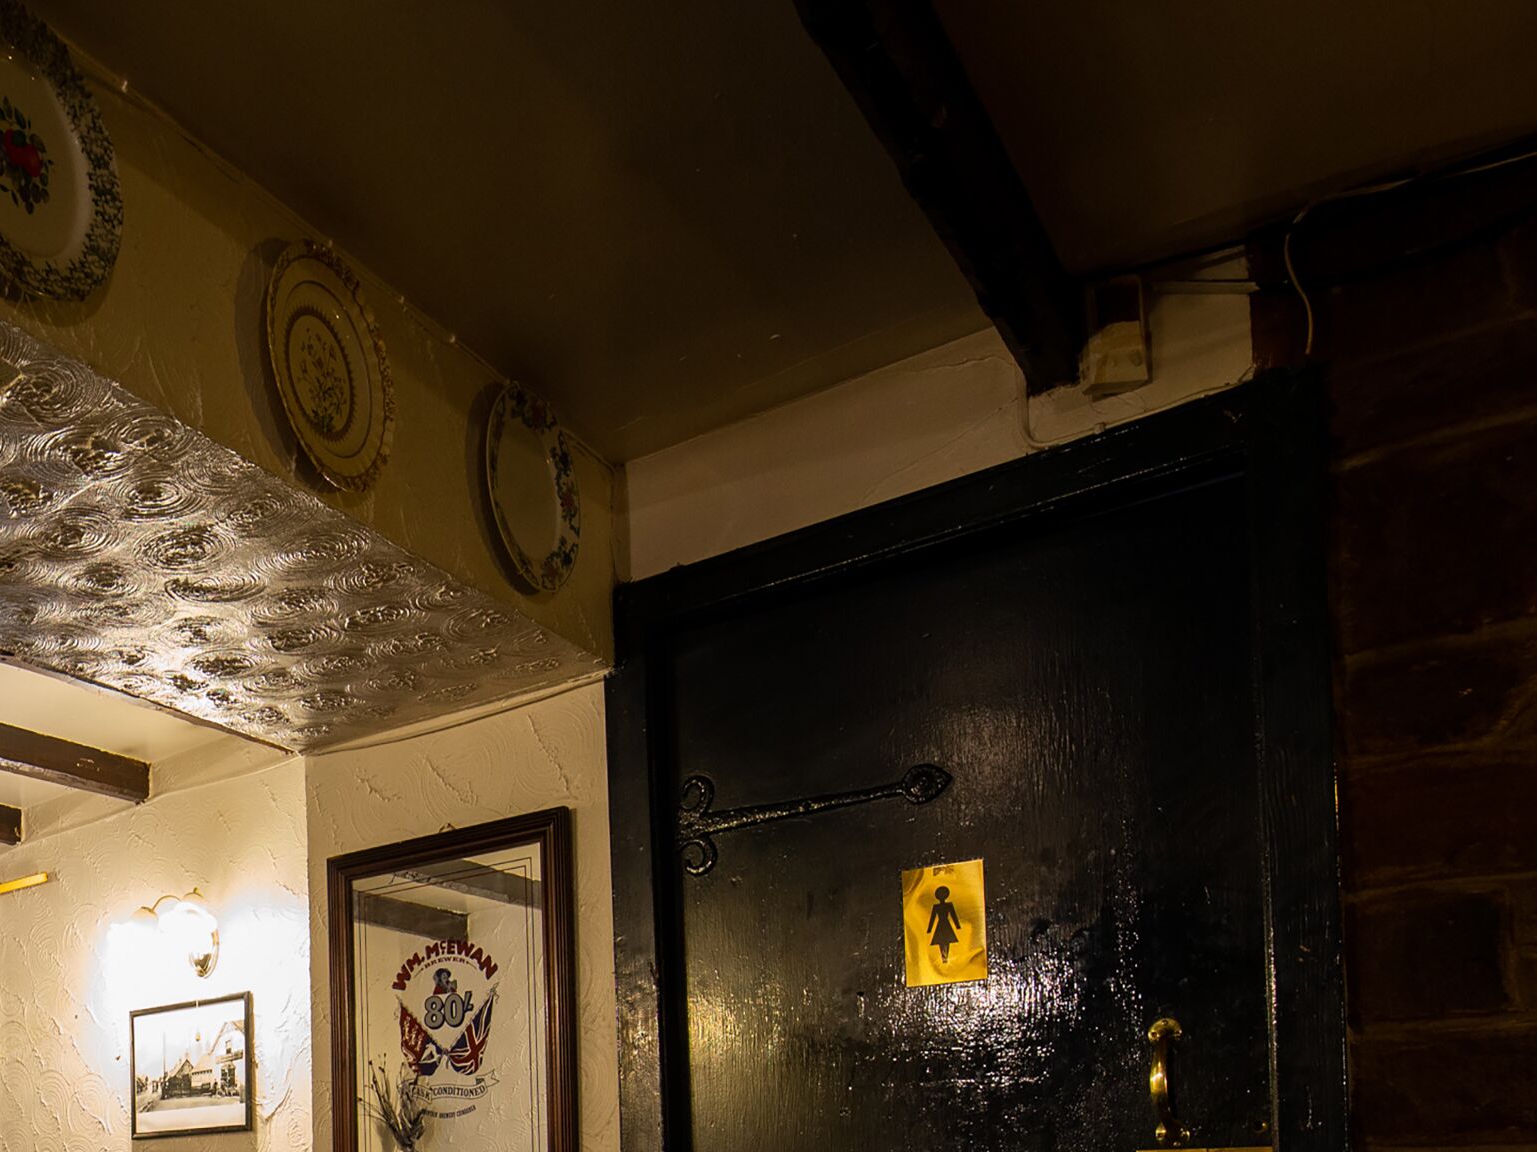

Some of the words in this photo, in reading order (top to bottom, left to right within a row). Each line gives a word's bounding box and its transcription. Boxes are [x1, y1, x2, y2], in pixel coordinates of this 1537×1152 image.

[424, 956, 466, 969] BREWER
[392, 952, 425, 991] WM.
[432, 1084, 486, 1097] CONDITIONED
